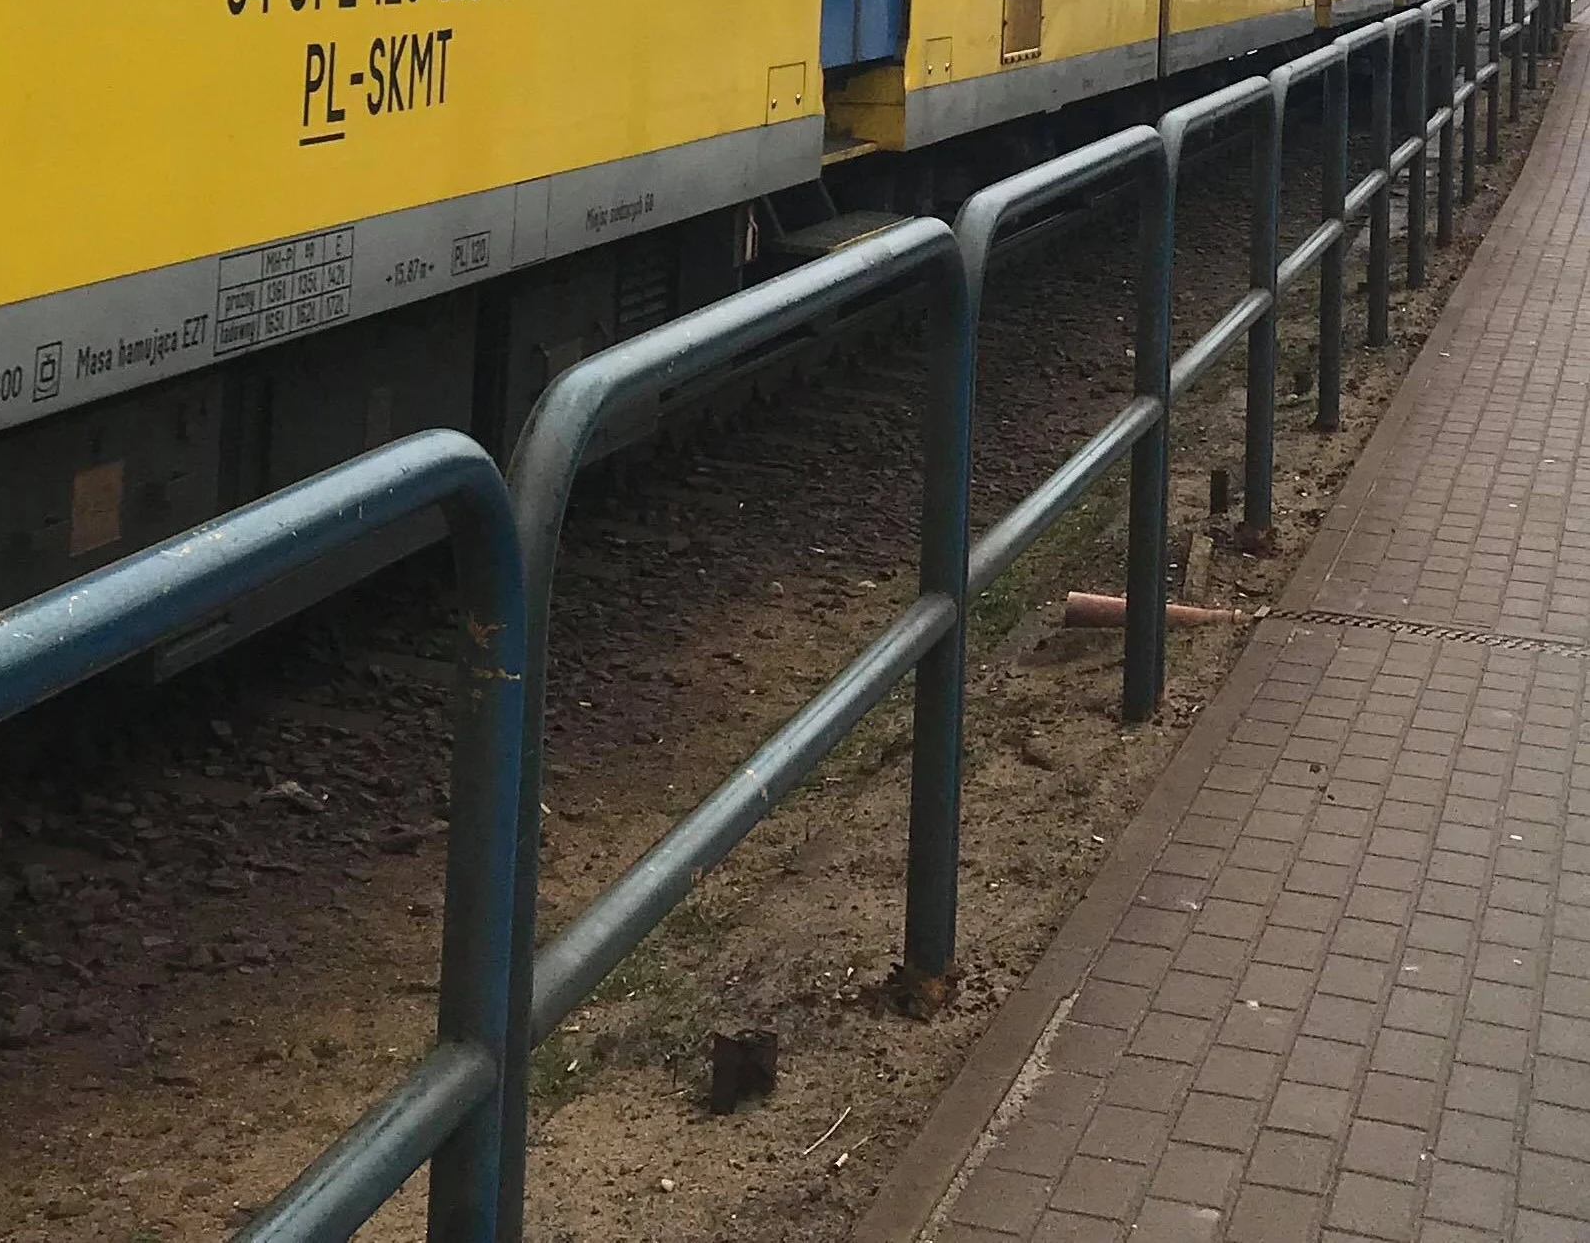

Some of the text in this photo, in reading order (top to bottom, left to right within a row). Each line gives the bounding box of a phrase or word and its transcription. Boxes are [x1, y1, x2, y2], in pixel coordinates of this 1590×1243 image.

[303, 28, 453, 127] PL-SKMT
[76, 346, 112, 380] Masa
[181, 313, 210, 350] EZT
